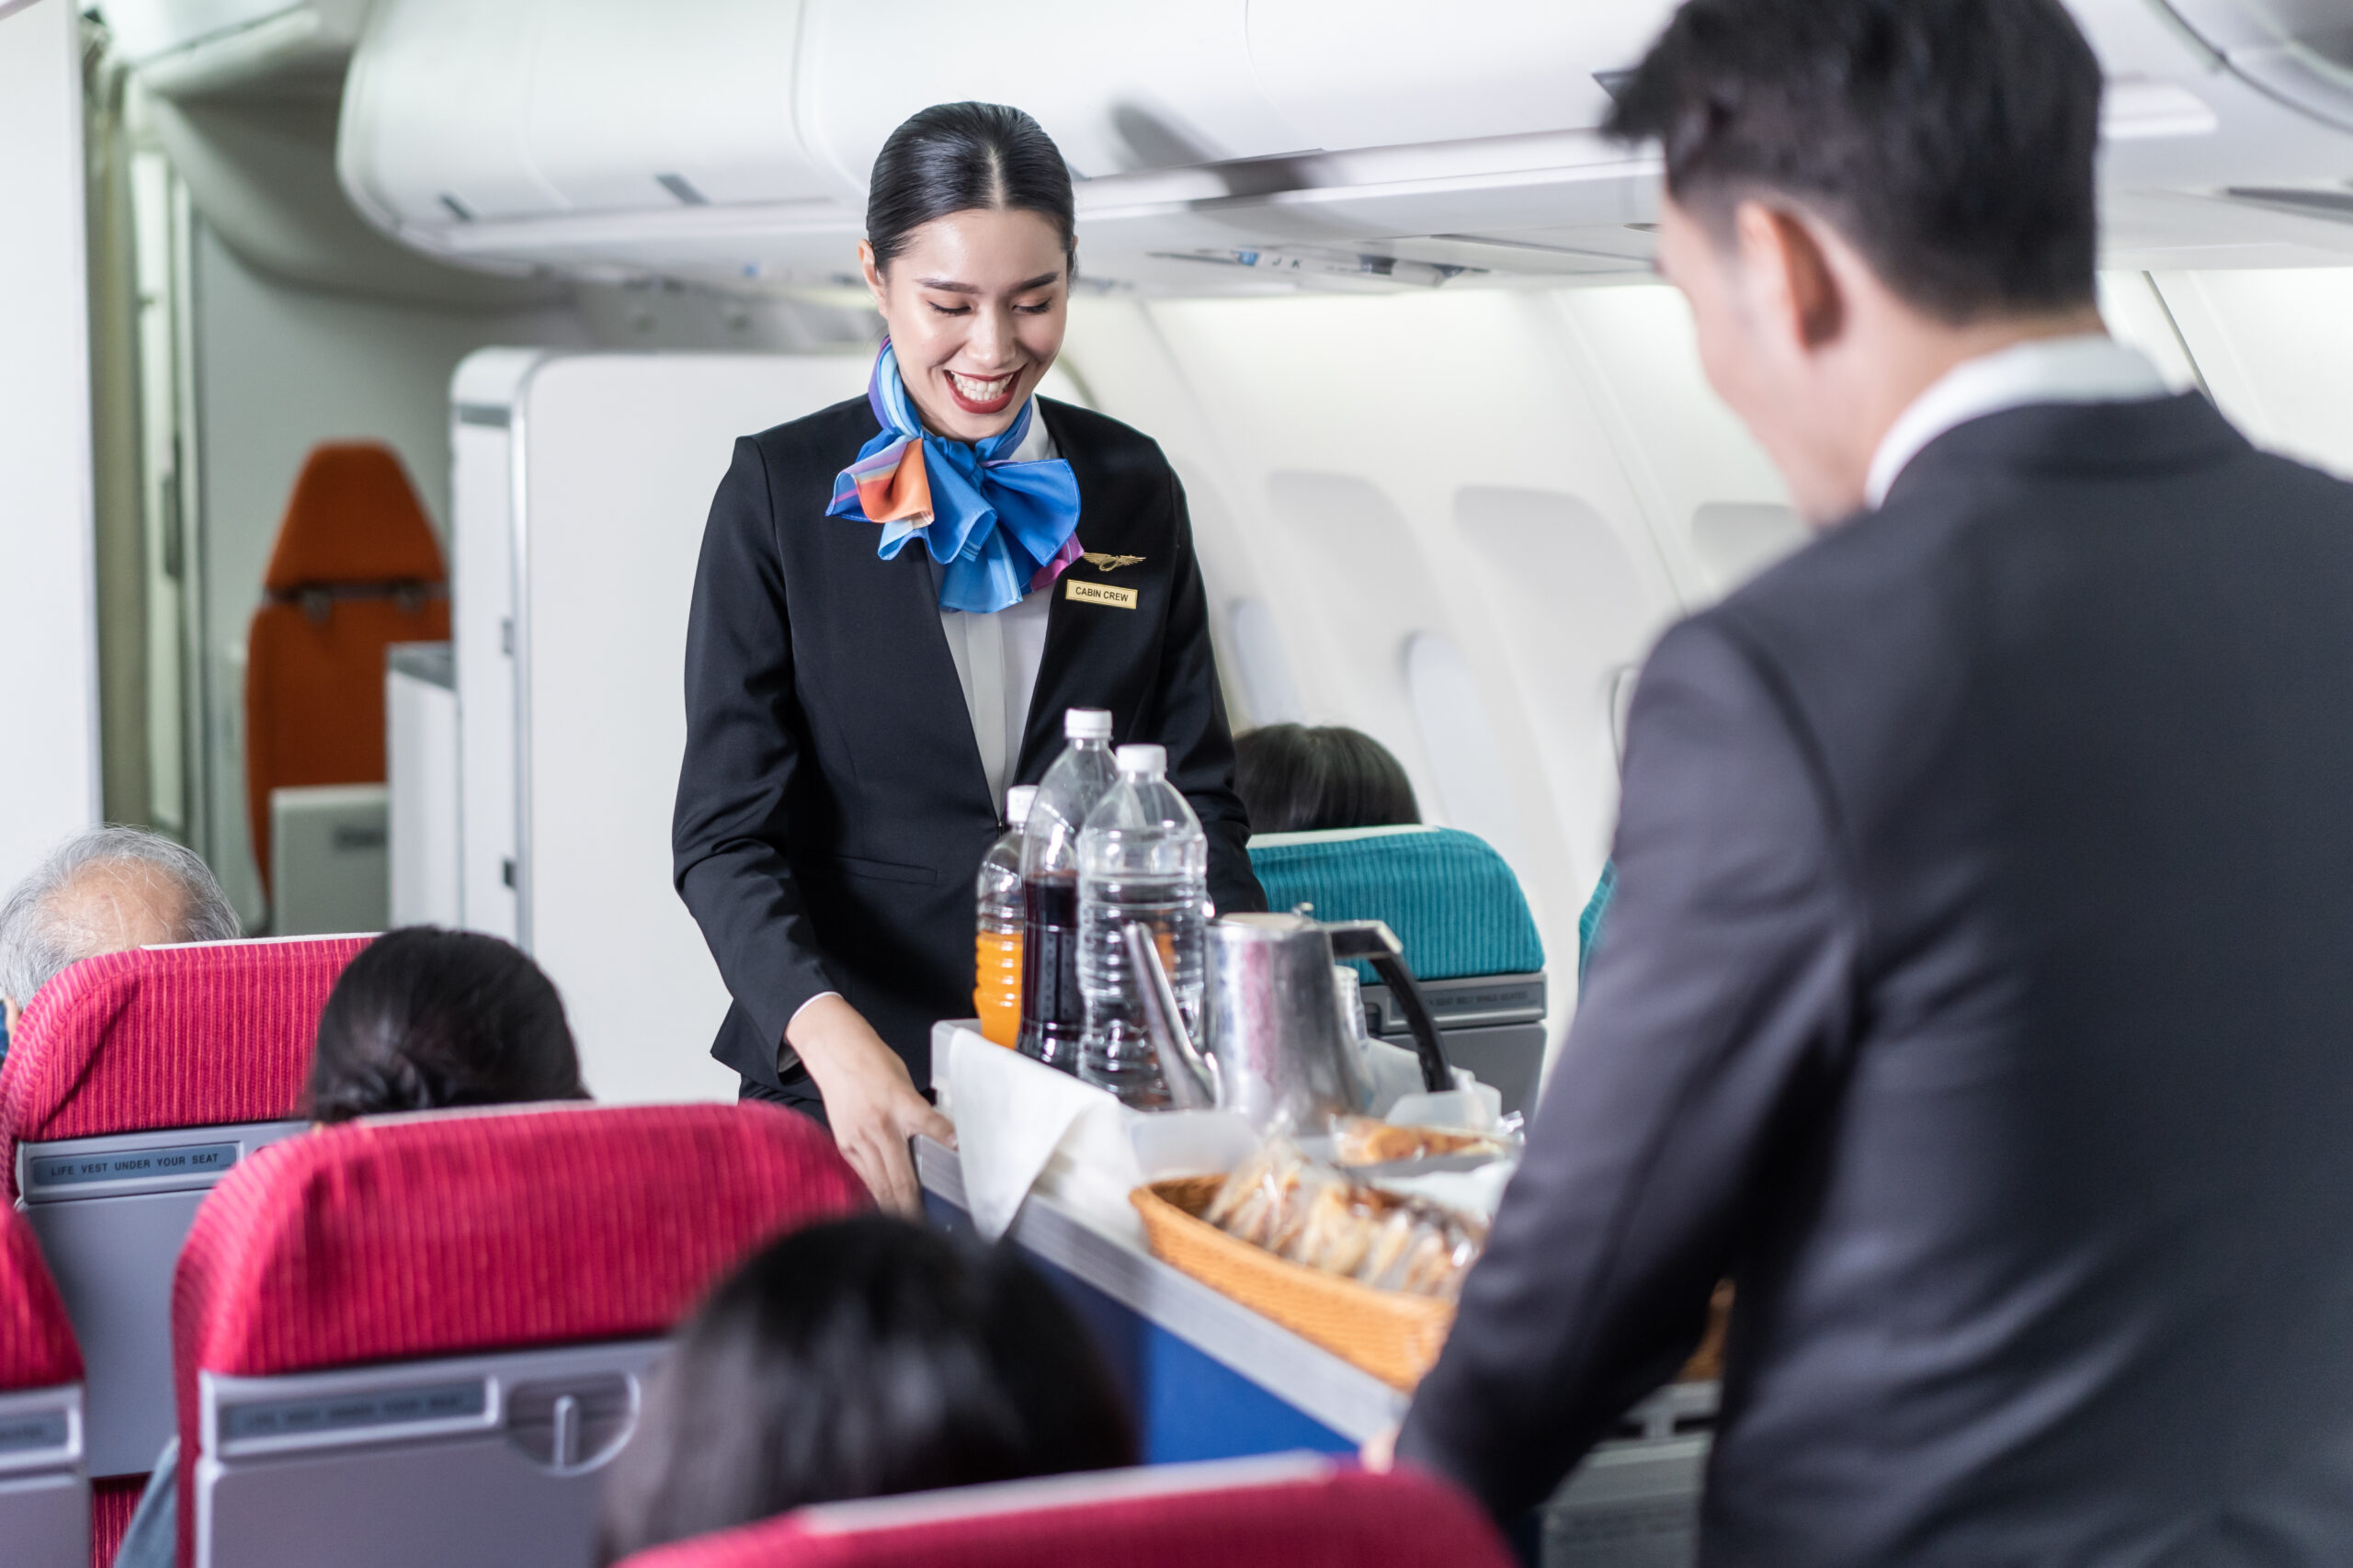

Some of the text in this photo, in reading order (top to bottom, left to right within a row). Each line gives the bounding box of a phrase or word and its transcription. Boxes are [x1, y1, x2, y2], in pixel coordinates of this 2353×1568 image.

[1075, 586, 1129, 602] CABIN CREW
[51, 1153, 220, 1176] LIFE VEST UNDER YOUR SEAT
